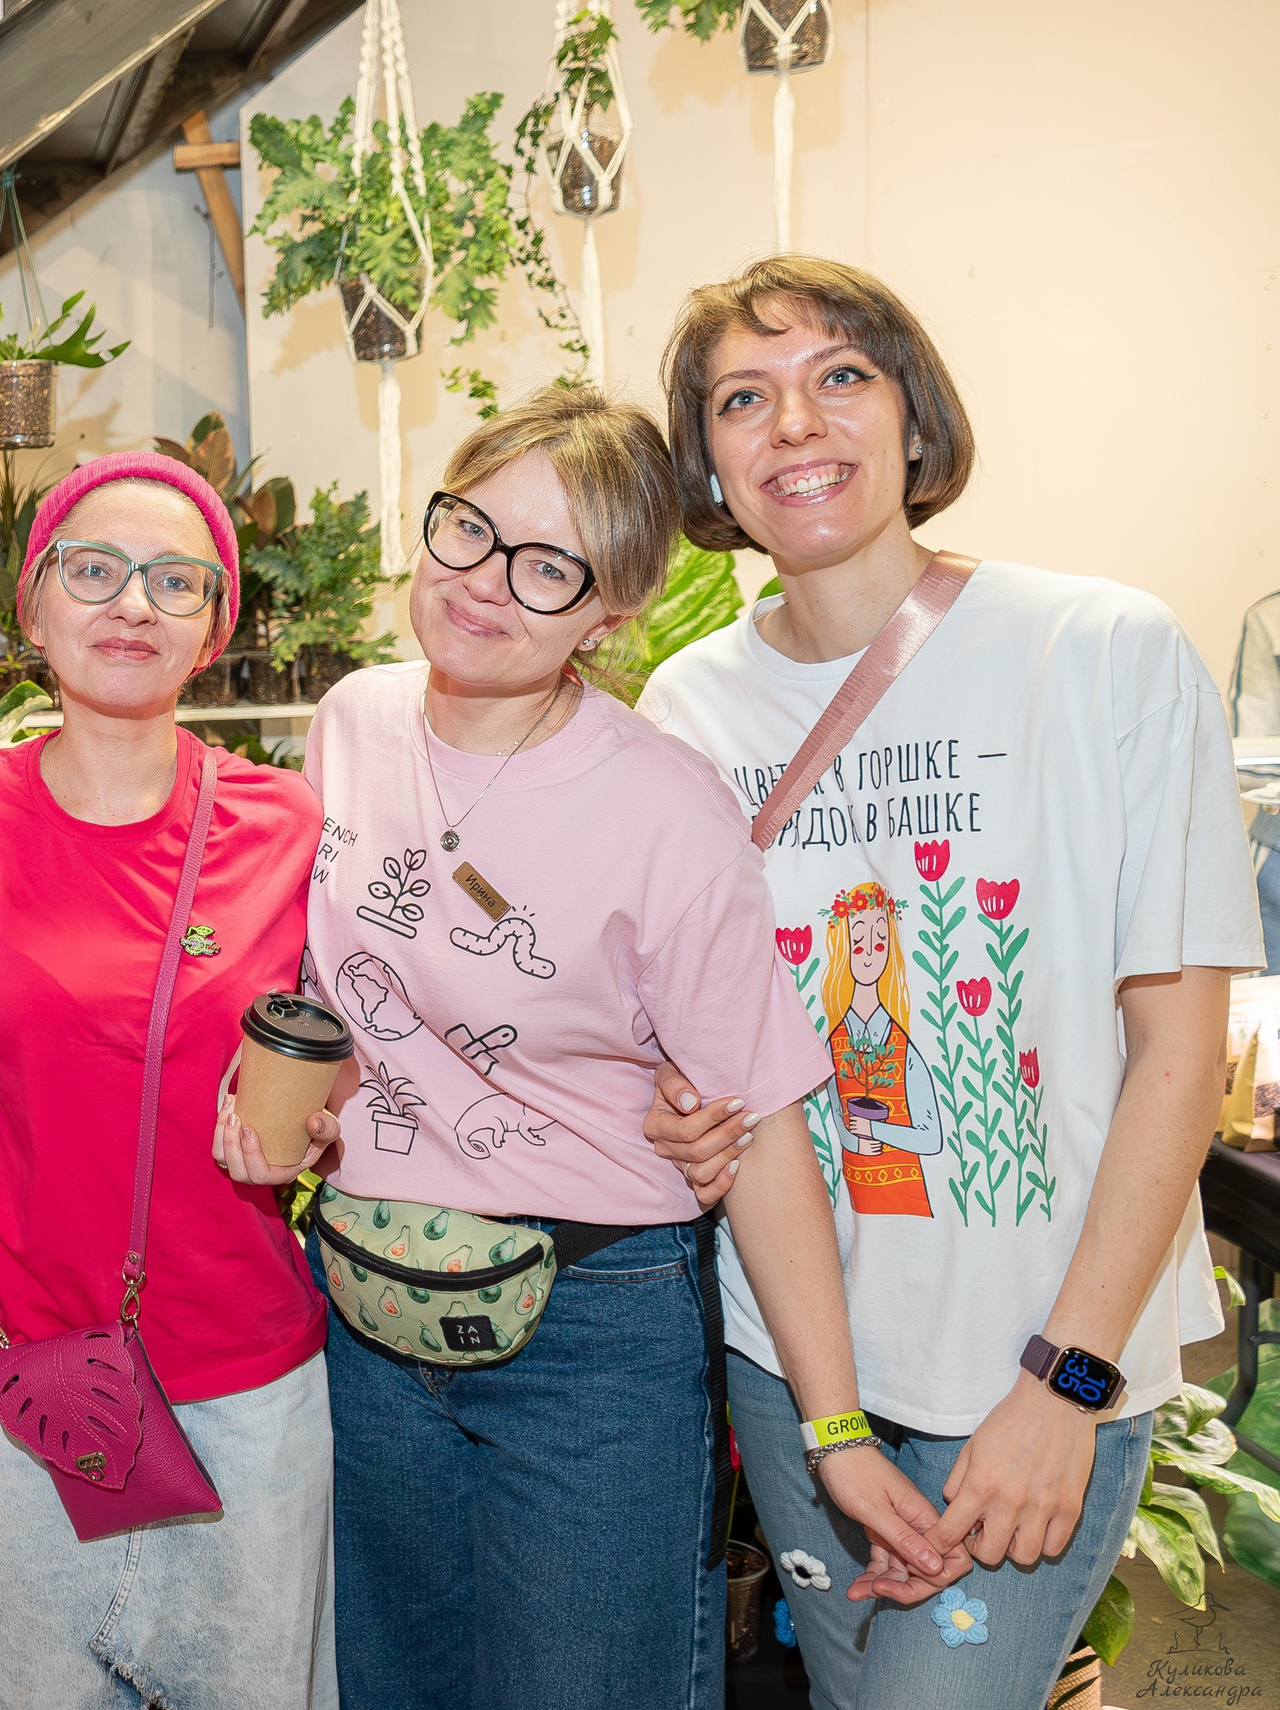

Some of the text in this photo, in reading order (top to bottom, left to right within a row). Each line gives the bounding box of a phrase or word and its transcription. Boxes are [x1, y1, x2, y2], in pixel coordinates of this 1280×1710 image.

[832, 754, 845, 793] В
[857, 739, 961, 791] ГОРШКЕ
[866, 802, 879, 843] В
[887, 792, 982, 840] БАШКЕ
[465, 873, 496, 908] Ирина
[1078, 1376, 1107, 1402] 10
[827, 1415, 871, 1436] GROW
